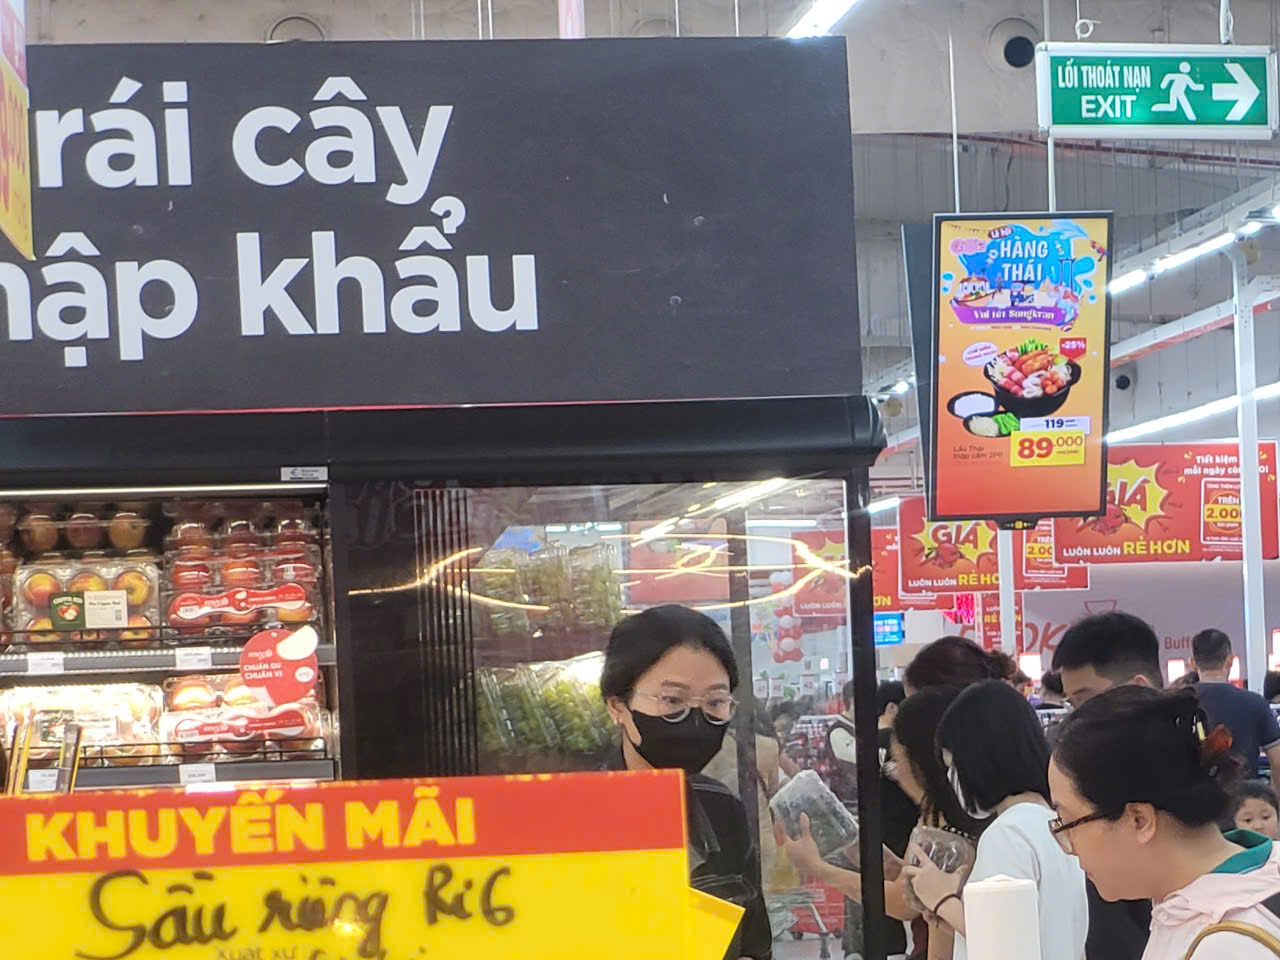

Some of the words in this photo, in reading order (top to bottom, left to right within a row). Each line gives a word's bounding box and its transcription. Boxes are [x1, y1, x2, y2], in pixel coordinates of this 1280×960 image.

[1057, 58, 1079, 88] LỐI
[1081, 60, 1121, 88] THOÁT
[1124, 64, 1151, 92] NẠN
[1081, 95, 1137, 118] EXIT
[231, 76, 453, 205] cây
[1000, 236, 1049, 259] HÀNG
[236, 196, 540, 337] khẩu
[1001, 260, 1044, 281] THÁI
[1044, 418, 1065, 429] 119
[1206, 507, 1241, 519] 2.00
[1063, 546, 1090, 557] LUÔN
[1093, 545, 1121, 556] LUÔN
[1123, 535, 1147, 555] RẺ
[1150, 539, 1190, 555] HƠN
[908, 578, 932, 587] LUÔN
[933, 577, 957, 586] LUÔN
[958, 569, 978, 586] RẺ
[25, 792, 325, 862] KHUYẾN
[345, 790, 477, 848] MÃI
